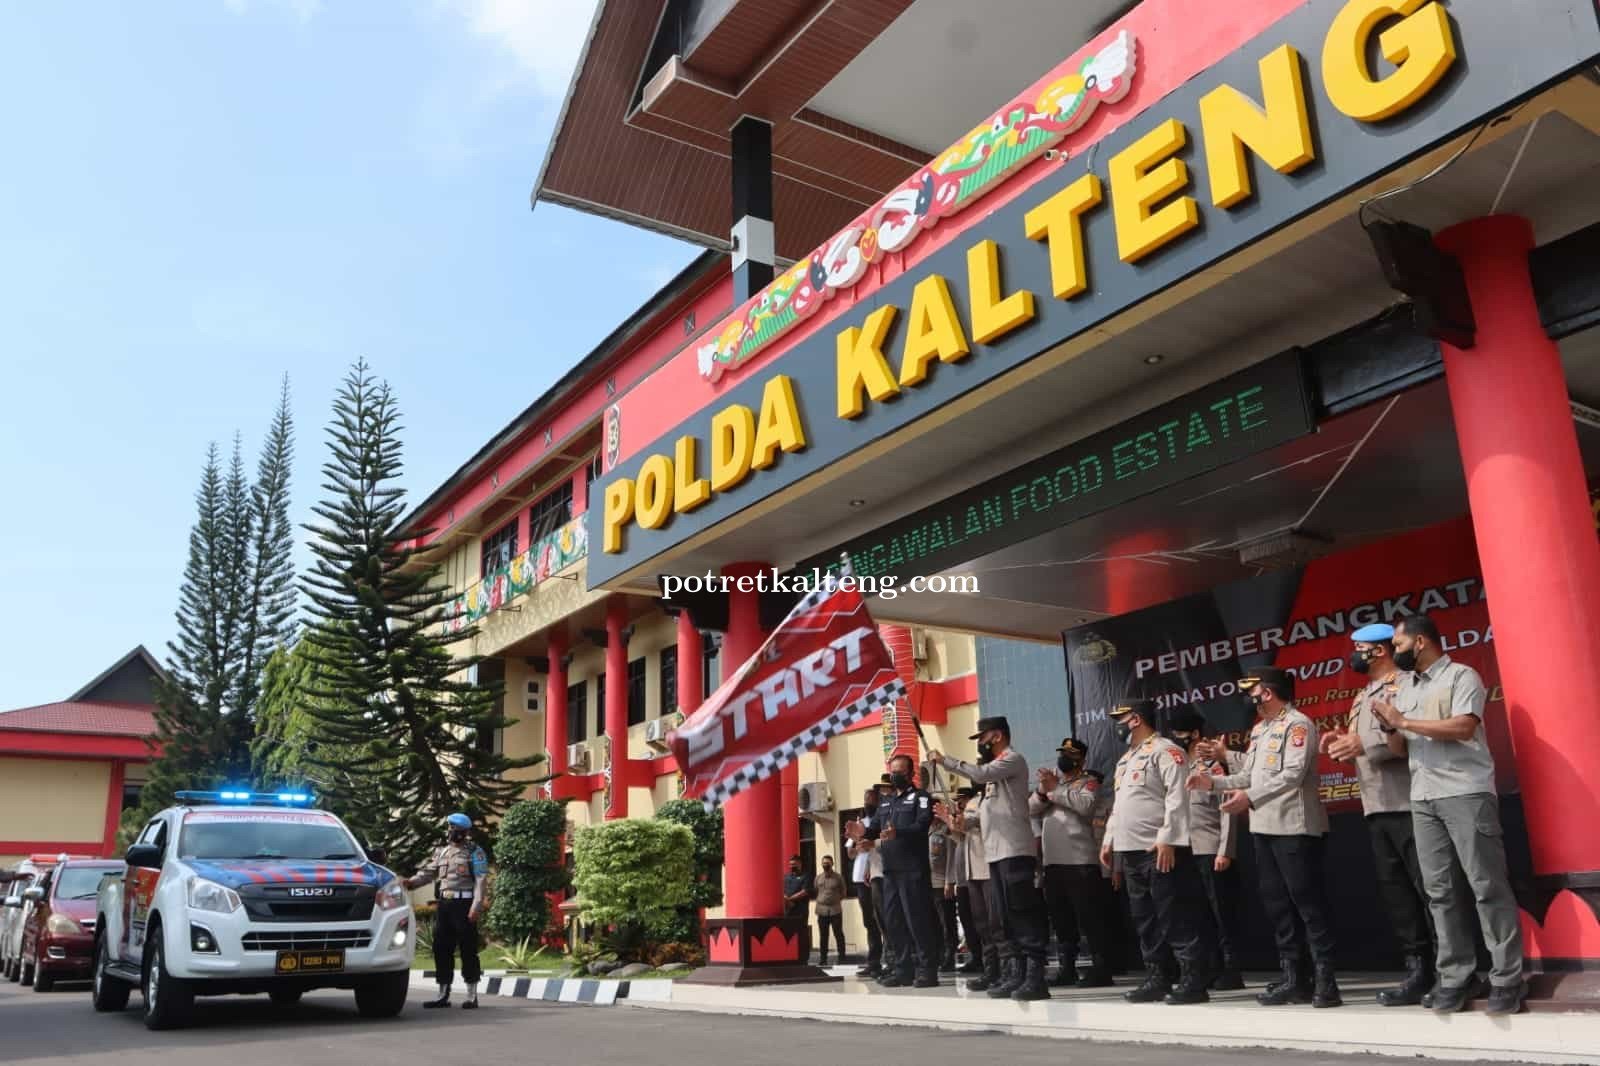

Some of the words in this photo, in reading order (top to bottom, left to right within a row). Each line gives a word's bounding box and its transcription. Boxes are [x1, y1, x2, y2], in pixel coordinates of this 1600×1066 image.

[603, 374, 806, 553] POLDA
[836, 0, 1456, 419] KALTENG
[1011, 455, 1104, 520] FOOD
[1112, 386, 1268, 480] ESTATE
[676, 626, 874, 768] START
[1075, 707, 1106, 725] TIM
[1150, 681, 1246, 711] SINATO
[291, 888, 333, 896] ISUZU
